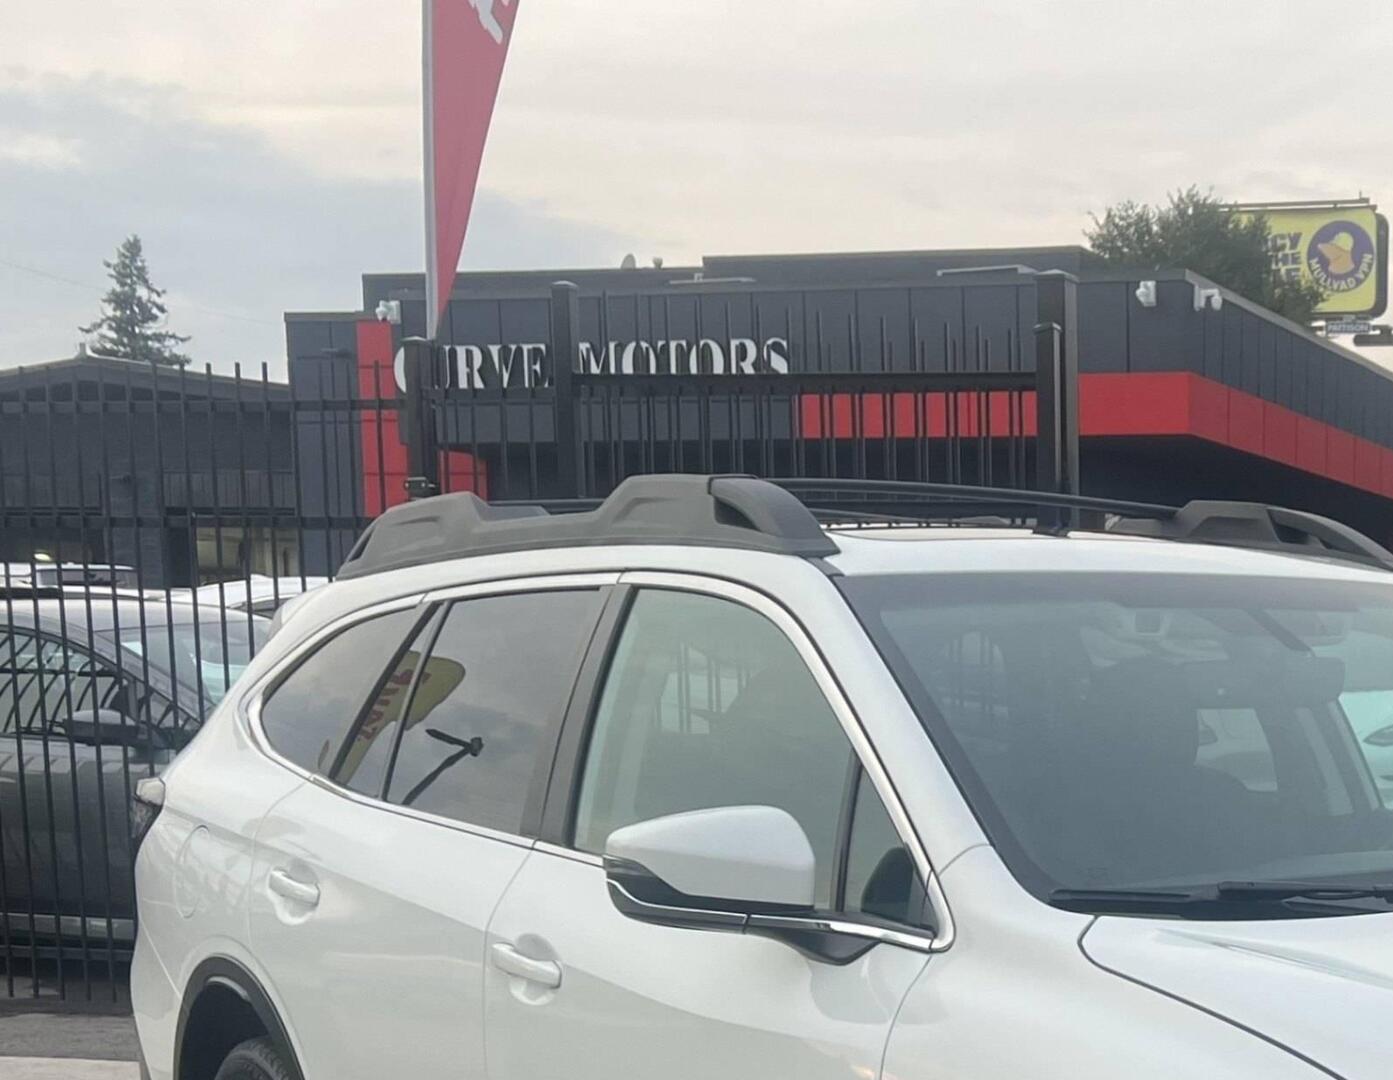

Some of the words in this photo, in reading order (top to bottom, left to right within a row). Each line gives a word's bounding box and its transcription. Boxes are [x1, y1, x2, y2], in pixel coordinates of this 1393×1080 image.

[1309, 257, 1357, 292] MULLVAD
[1354, 253, 1374, 280] VPN
[578, 336, 789, 376] MOTORS
